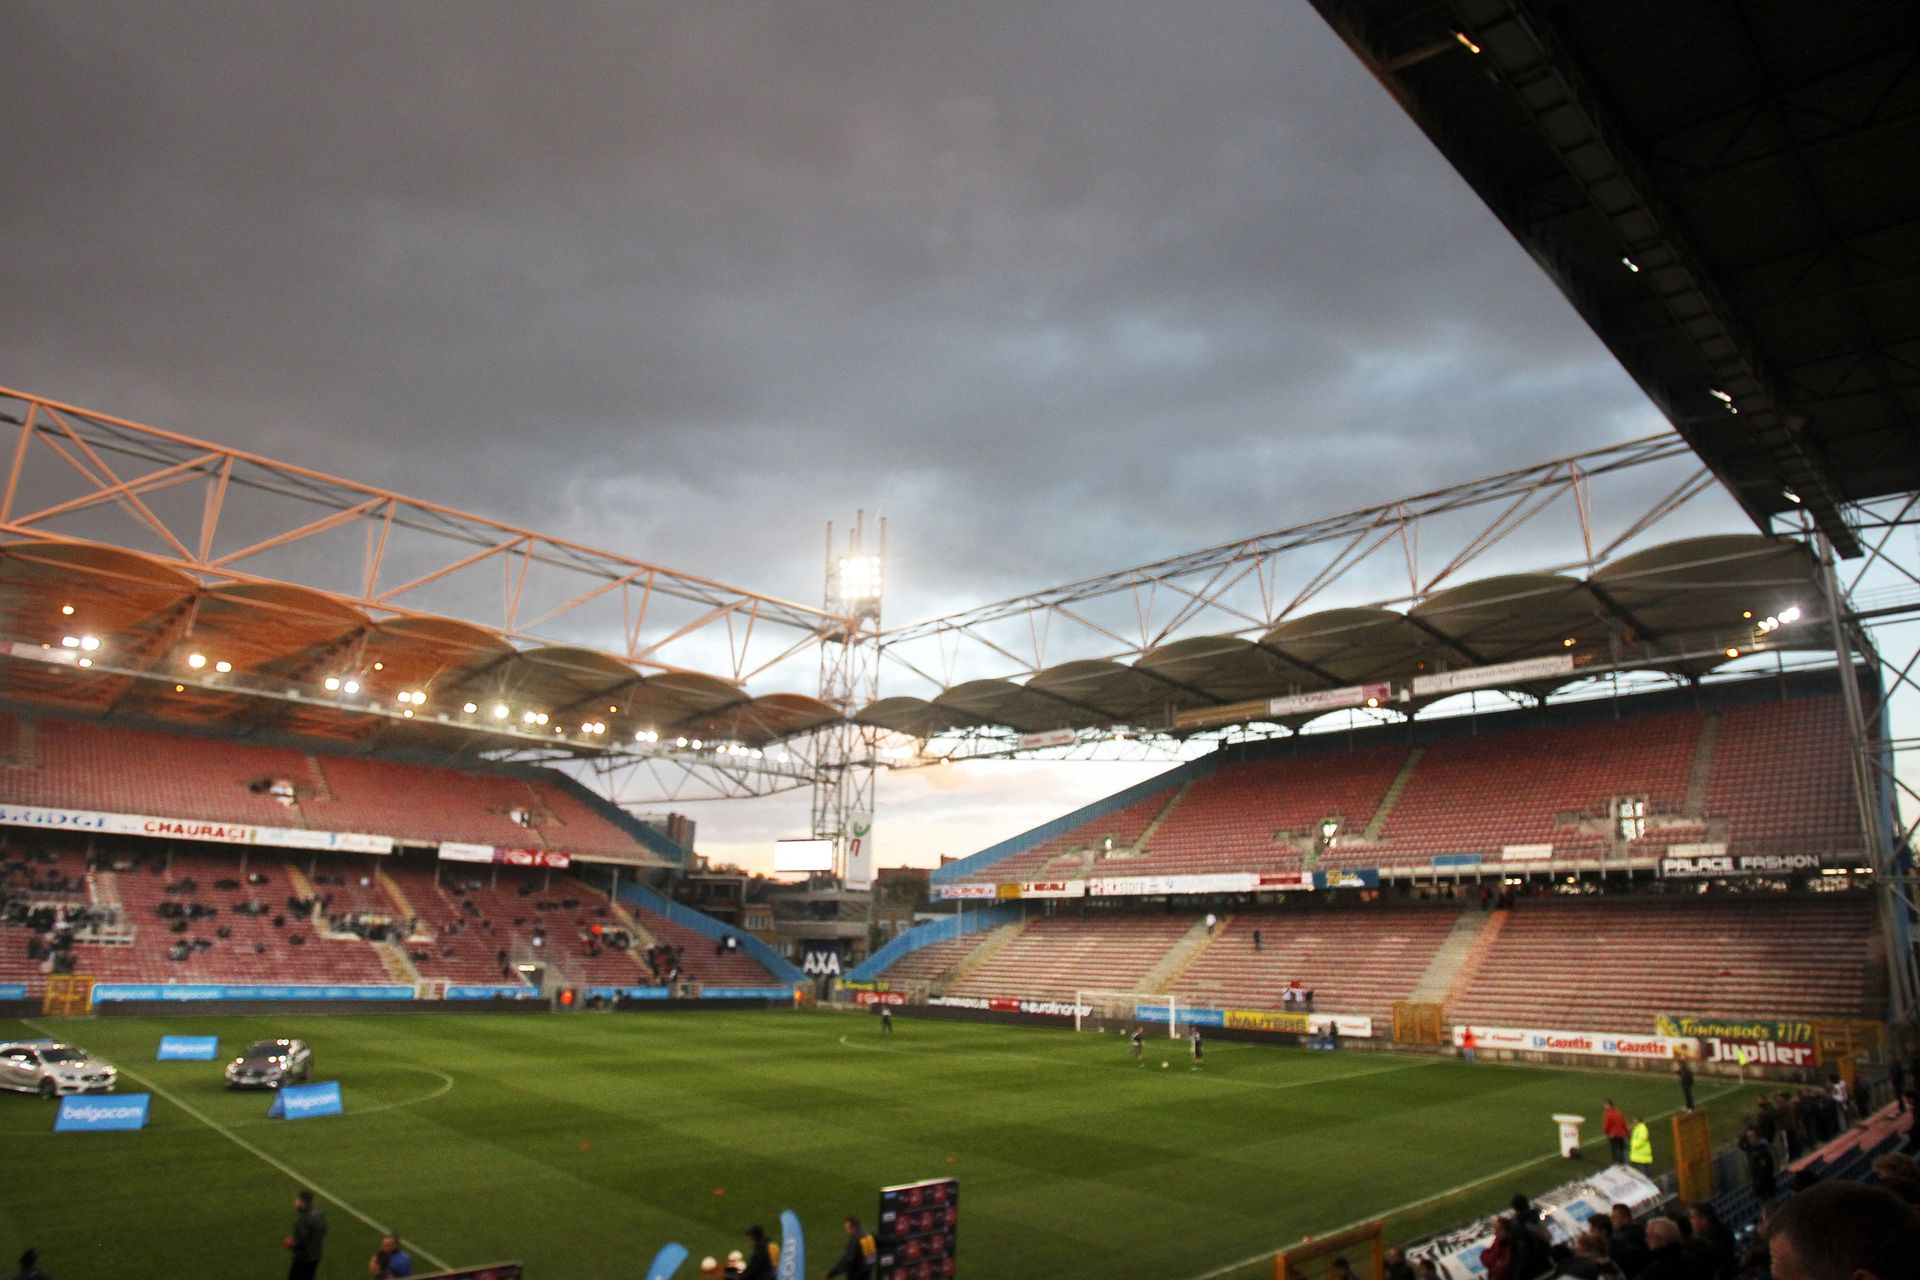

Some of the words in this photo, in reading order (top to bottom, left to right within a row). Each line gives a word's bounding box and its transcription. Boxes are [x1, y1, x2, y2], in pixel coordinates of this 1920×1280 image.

[1664, 857, 1733, 871] PALACE
[1741, 854, 1819, 869] FASHION
[803, 951, 840, 975] AXA
[1706, 1037, 1812, 1065] Jupiler
